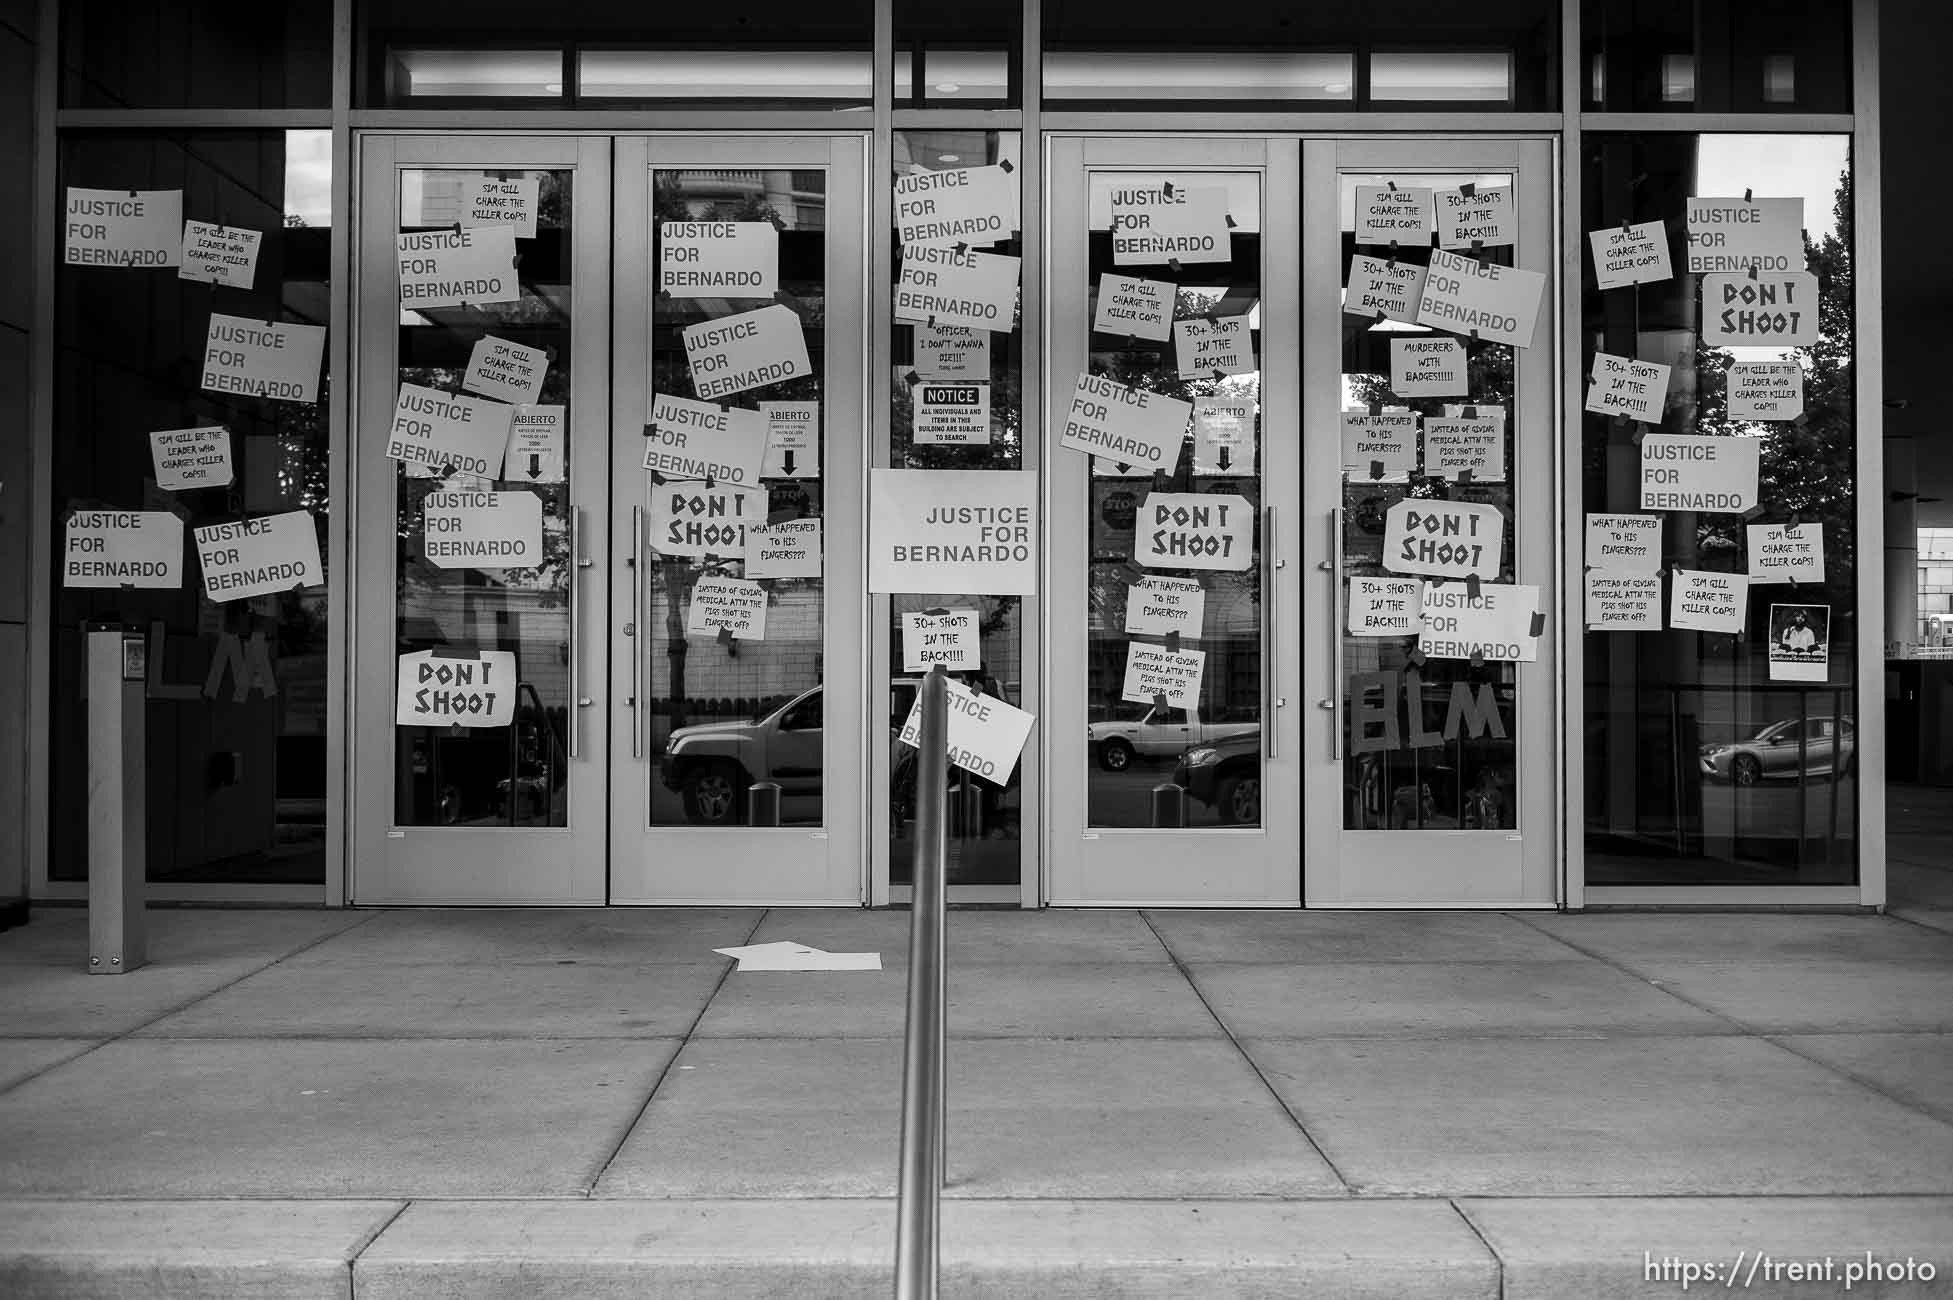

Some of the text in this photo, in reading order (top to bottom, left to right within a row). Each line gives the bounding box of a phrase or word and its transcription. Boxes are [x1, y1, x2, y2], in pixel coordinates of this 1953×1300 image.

[898, 171, 968, 194] JUSTICE
[1447, 193, 1501, 206] 30+ SHOTS
[69, 199, 144, 217] JUSTICE
[901, 200, 935, 218] FOR
[1458, 210, 1493, 222] IN THE
[1689, 209, 1760, 223] JUSTICE
[904, 216, 1001, 241] BERNARDO
[1114, 215, 1150, 229] FOR
[69, 224, 106, 240] FOR
[664, 224, 736, 238] JUSTICE
[399, 233, 472, 250] JUSTICE
[1115, 236, 1215, 253] BERNARDO
[1690, 233, 1725, 247] FOR
[68, 247, 168, 265] BERNARDO
[665, 248, 699, 262] FOR
[905, 246, 976, 268] JUSTICE
[401, 260, 437, 274] FOR
[1692, 256, 1787, 271] BERNARDO
[664, 271, 762, 286] BERNARDO
[902, 269, 938, 287] FOR
[1427, 274, 1460, 296] FOR
[403, 279, 501, 298] BERNARDO
[900, 292, 997, 319] BERNARDO
[1422, 297, 1516, 332] BERNARDO
[1721, 308, 1800, 334] SHOOT
[210, 326, 286, 348] JUSTICE
[688, 321, 758, 351] JUSTICE
[1185, 322, 1239, 336] 30+ SHOTS
[1197, 339, 1231, 352] IN THE
[1405, 343, 1453, 352] MURDERERS
[208, 349, 245, 368] FOR
[693, 354, 728, 375] FOR
[1418, 357, 1440, 368] WITH
[1605, 360, 1658, 379] 30+ SHOTS
[205, 373, 303, 399] BERNARDO
[700, 360, 795, 398] BERNARDO
[1611, 378, 1646, 393] IN THE
[928, 390, 974, 402] NOTICE
[1079, 377, 1150, 408] JUSTICE
[400, 395, 472, 422] JUSTICE
[1072, 399, 1107, 421] FOR
[514, 415, 556, 424] ABIERTO
[656, 406, 728, 431] JUSTICE
[396, 418, 432, 438] FOR
[1065, 423, 1161, 461] BERNARDO
[391, 441, 487, 473] BERNARDO
[1644, 445, 1716, 461] JUSTICE
[647, 452, 743, 482] BERNARDO
[1645, 469, 1679, 483] FOR
[427, 493, 498, 508] JUSTICE
[1645, 493, 1742, 509] BERNARDO
[70, 514, 141, 528] JUSTICE
[926, 508, 1028, 523] JUSTICE
[1593, 519, 1656, 528] WHAT HAPPENED
[198, 519, 272, 544] JUSTICE
[428, 518, 462, 532] FOR
[981, 527, 1028, 542] FOR
[1611, 532, 1637, 542] TO HIS
[70, 538, 104, 552] FOR
[427, 540, 526, 556] BERNARDO
[1152, 530, 1232, 557] SHOOT
[1401, 536, 1482, 567] SHOOT
[203, 549, 239, 567] FOR
[893, 546, 1028, 562] BERNARDO
[69, 562, 168, 577] BERNARDO
[207, 561, 306, 591] BERNARDO
[1361, 583, 1415, 594] 30+ SHOTS
[1371, 601, 1405, 610] IN THE
[1424, 594, 1495, 609] JUSTICE
[914, 617, 968, 628] 30+ SHOTS
[1424, 617, 1457, 632] FOR
[924, 634, 958, 646] IN THE
[415, 688, 496, 715] SHOOT
[1351, 671, 1506, 756] BLM
